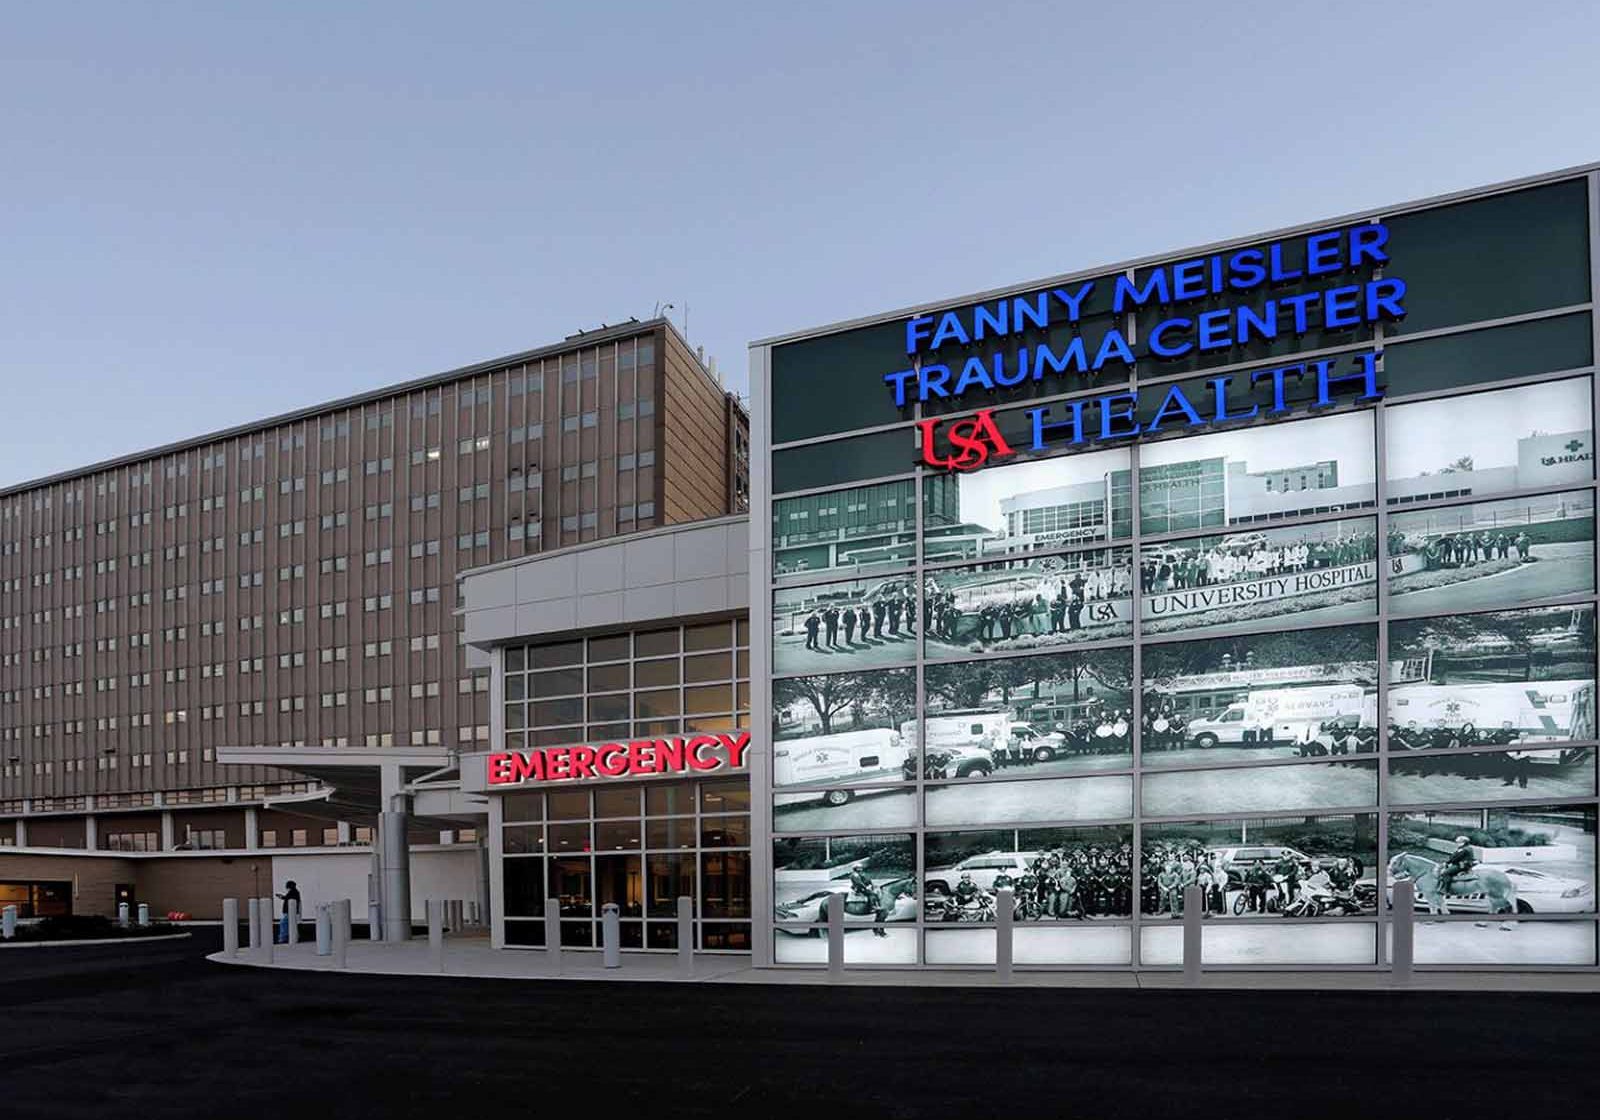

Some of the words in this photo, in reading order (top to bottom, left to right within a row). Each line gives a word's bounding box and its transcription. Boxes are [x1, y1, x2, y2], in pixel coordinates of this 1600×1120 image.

[906, 282, 1095, 354] FANNY
[1112, 223, 1390, 313] MEISLER
[884, 329, 1136, 408] TRAUMA
[1148, 277, 1407, 358] CENTER
[916, 409, 1015, 470] USA
[1026, 351, 1384, 451] HEALTH
[1034, 528, 1097, 542] EMERGENCY
[1088, 603, 1119, 622] USA
[1151, 578, 1289, 615] UNIVERSITY
[1295, 564, 1372, 592] HOSPITAL
[488, 732, 750, 785] EMERGENCY
